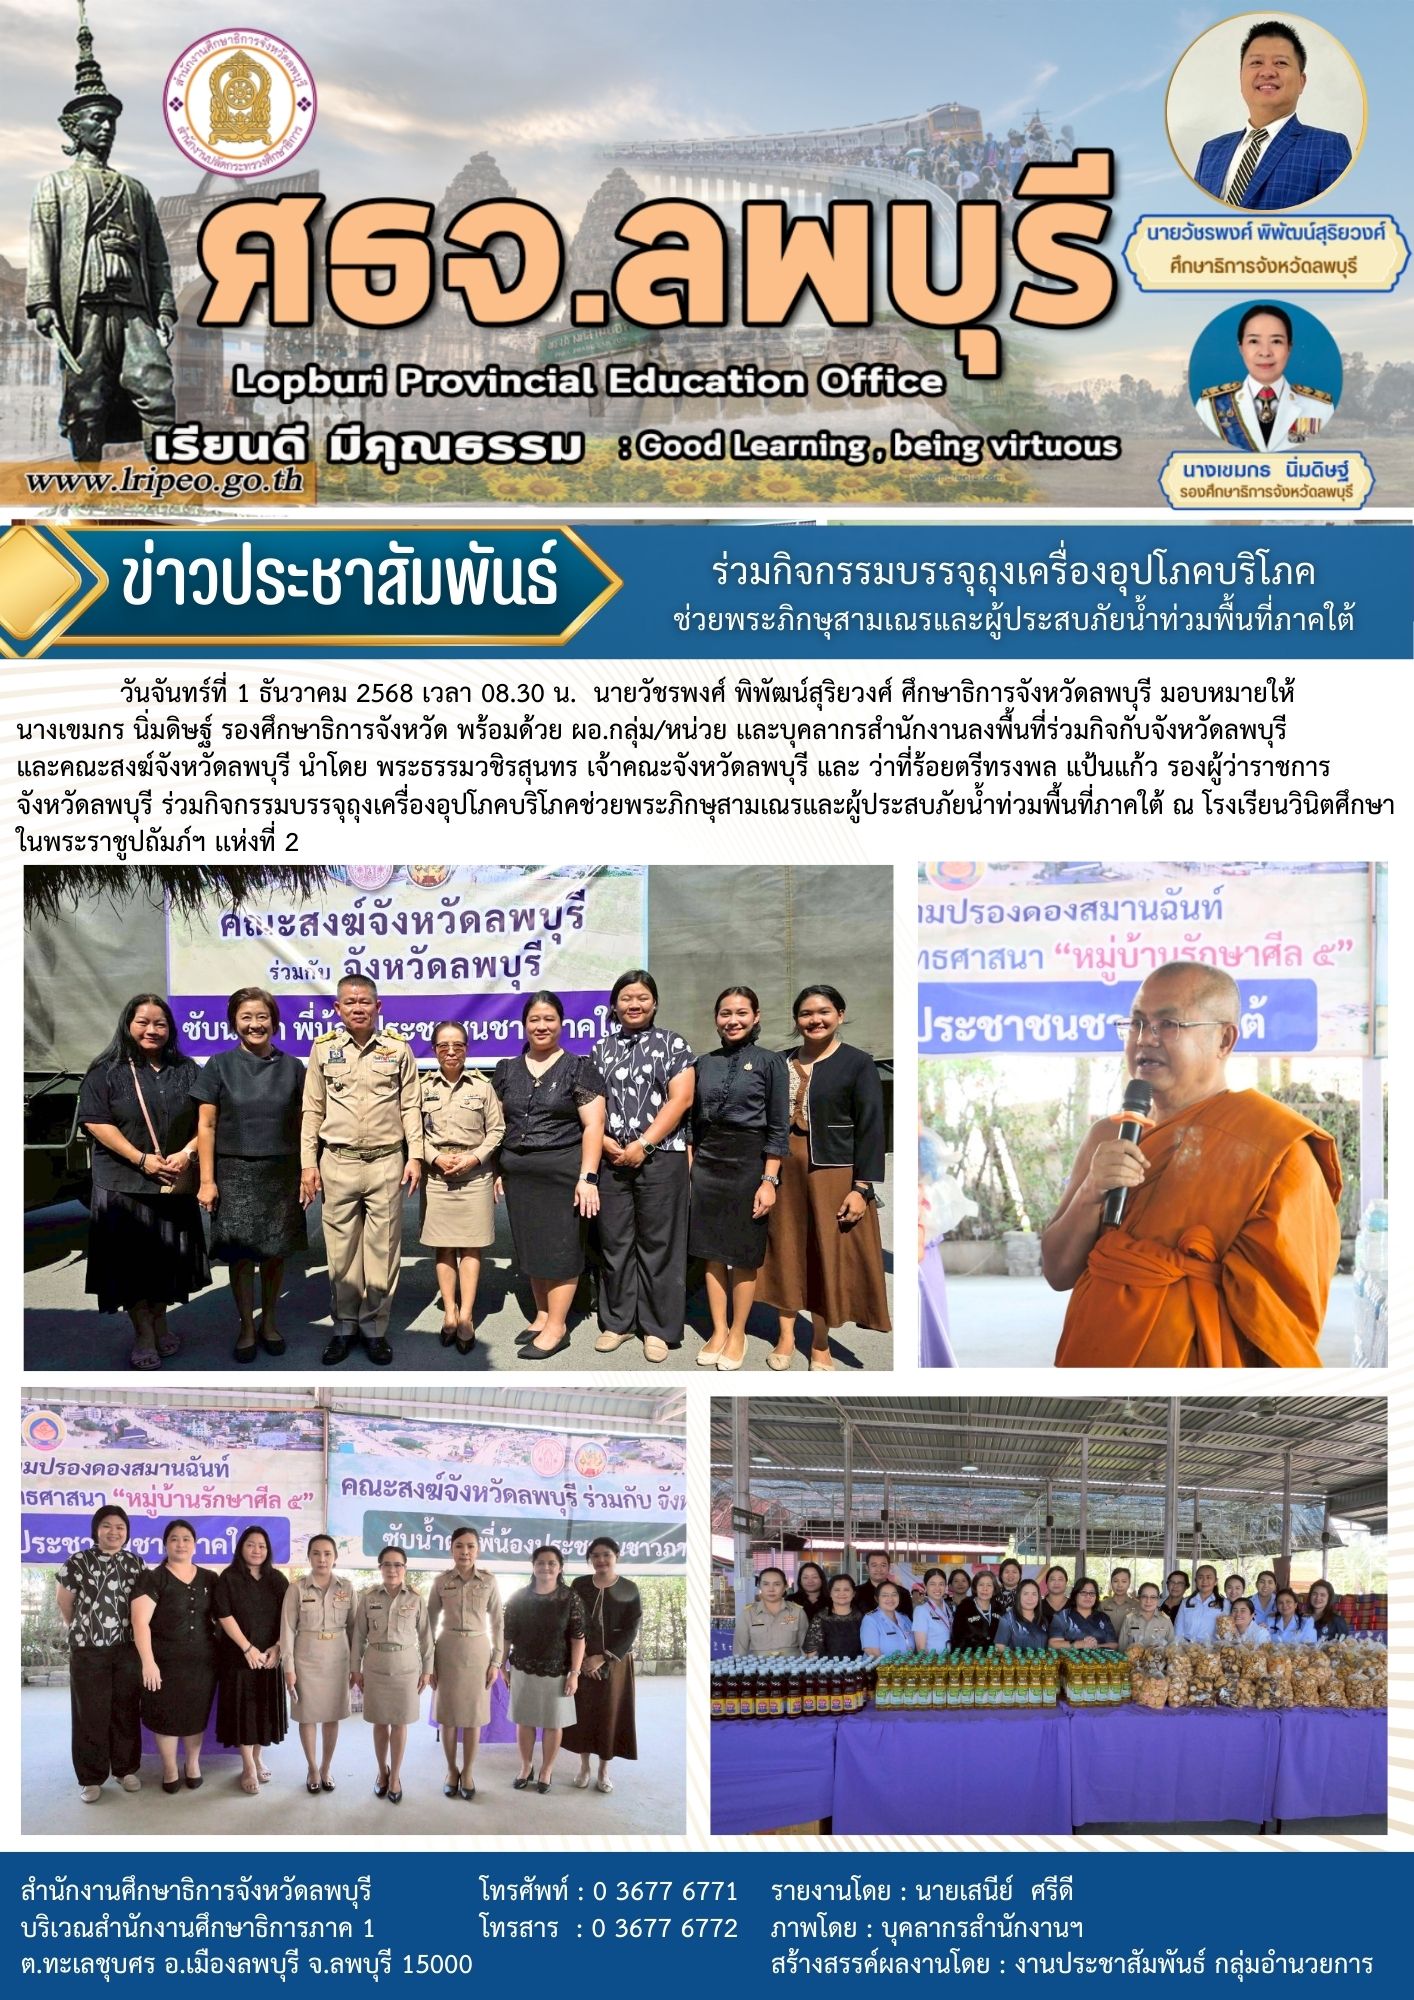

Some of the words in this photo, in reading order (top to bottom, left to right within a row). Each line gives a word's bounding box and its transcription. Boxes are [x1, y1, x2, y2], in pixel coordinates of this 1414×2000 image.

[341, 1471, 578, 1516] คณะสงฆ์จังหวัดลพบุรี
[583, 1484, 652, 1510] ร่วมกับ
